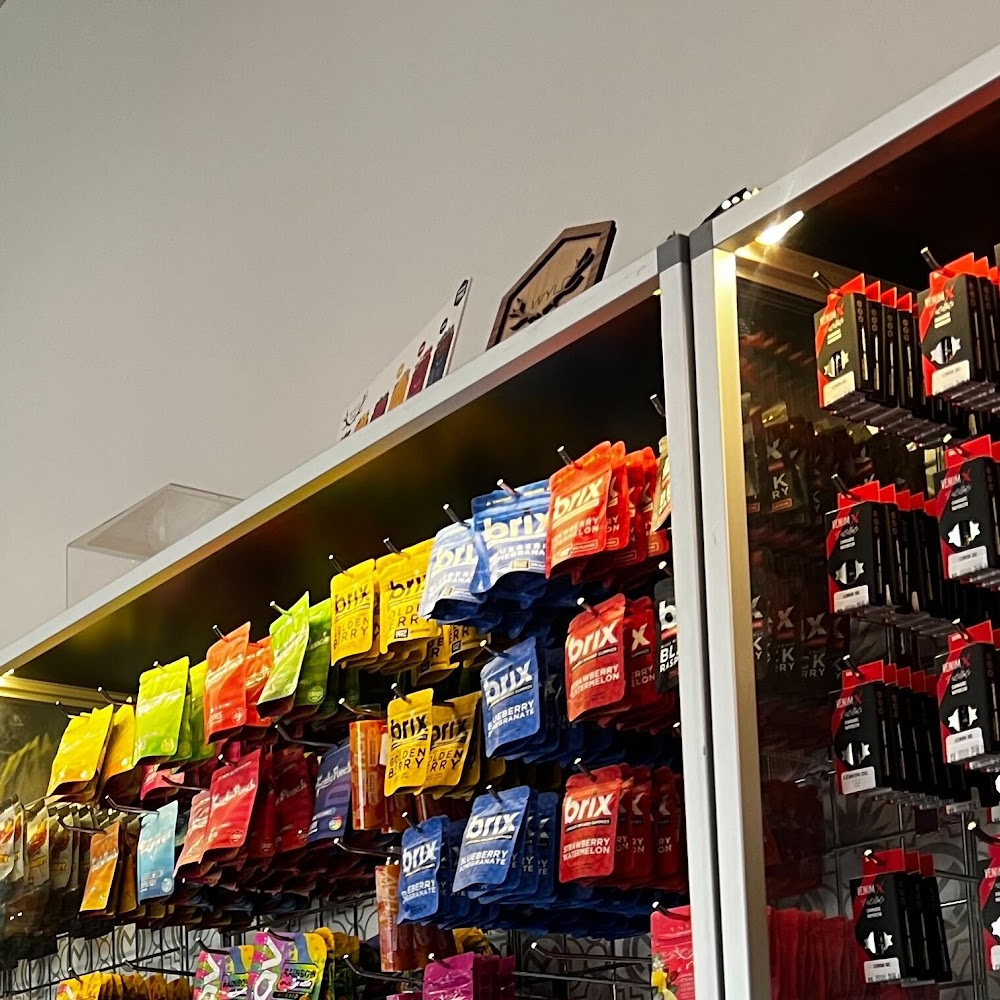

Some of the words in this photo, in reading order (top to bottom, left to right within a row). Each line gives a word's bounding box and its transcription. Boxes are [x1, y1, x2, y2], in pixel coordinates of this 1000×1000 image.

[553, 476, 604, 521] brix
[335, 584, 370, 615] brix
[568, 620, 620, 665] brix
[483, 659, 533, 706] brix
[391, 713, 428, 743] brix
[565, 793, 614, 825] brix
[466, 812, 521, 839] brix
[402, 839, 437, 873] brix
[460, 849, 509, 864] BLUEBERRY
[562, 845, 611, 861] WATERMELON
[563, 837, 611, 854] STRAWBERRY
